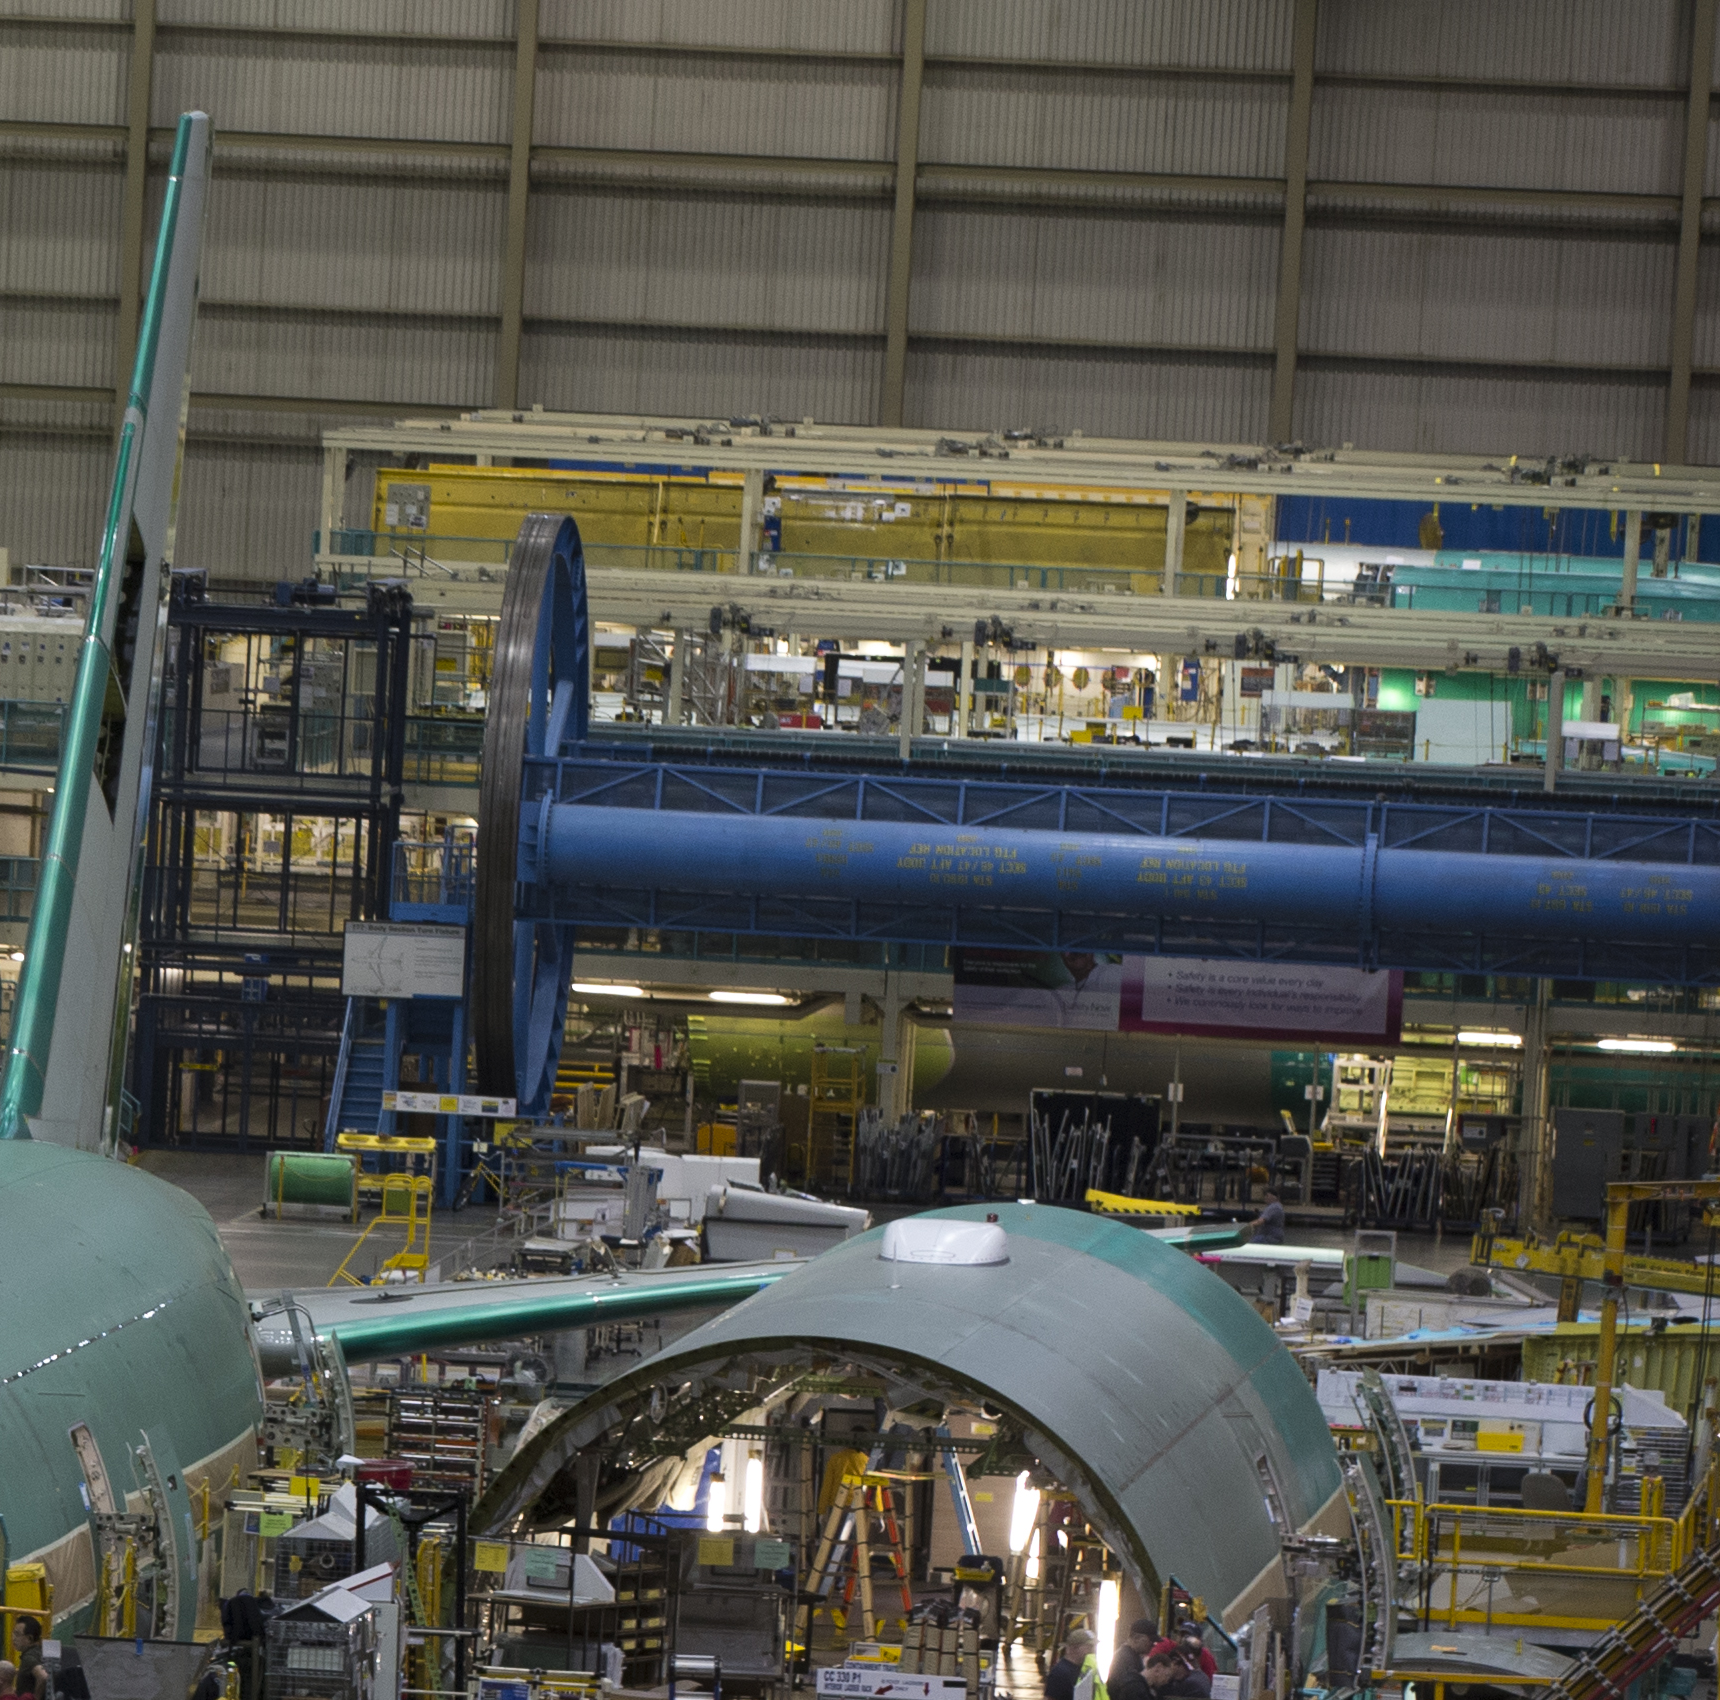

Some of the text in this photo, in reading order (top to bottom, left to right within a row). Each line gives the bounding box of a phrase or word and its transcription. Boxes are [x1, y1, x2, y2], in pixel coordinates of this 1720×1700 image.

[1176, 970, 1205, 983] Safety
[1278, 977, 1303, 988] every
[1305, 977, 1324, 989] day
[1175, 983, 1204, 995] Safety
[824, 1671, 835, 1681] CC
[837, 1671, 850, 1683] 330
